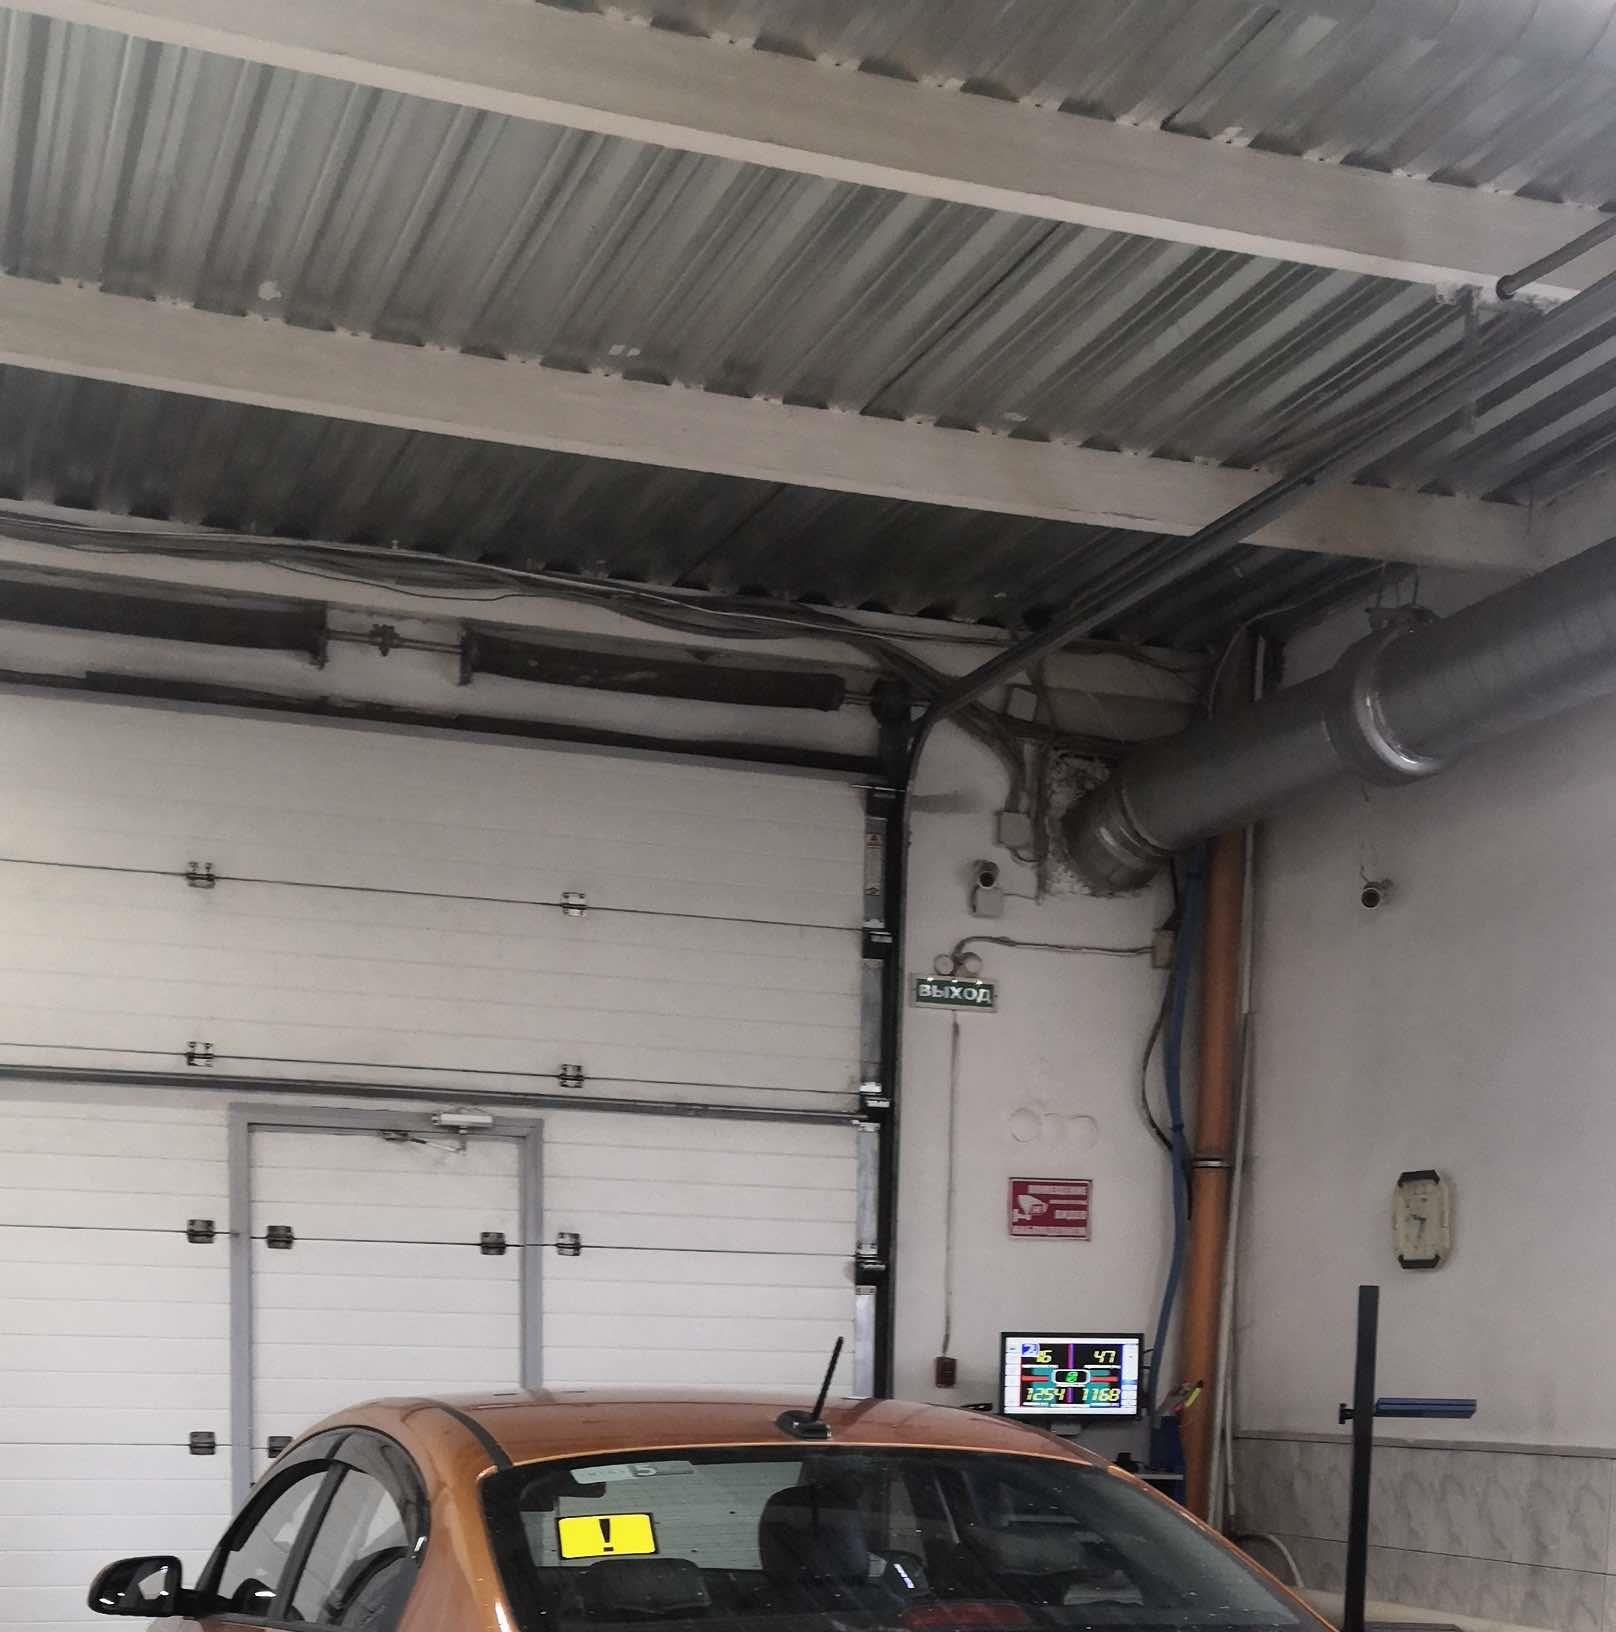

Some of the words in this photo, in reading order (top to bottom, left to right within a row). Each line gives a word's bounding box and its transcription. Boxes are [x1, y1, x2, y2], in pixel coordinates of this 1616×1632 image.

[919, 984, 992, 1003] ВЫХОД
[1093, 1350, 1116, 1363] 47
[1025, 1387, 1066, 1401] 1254
